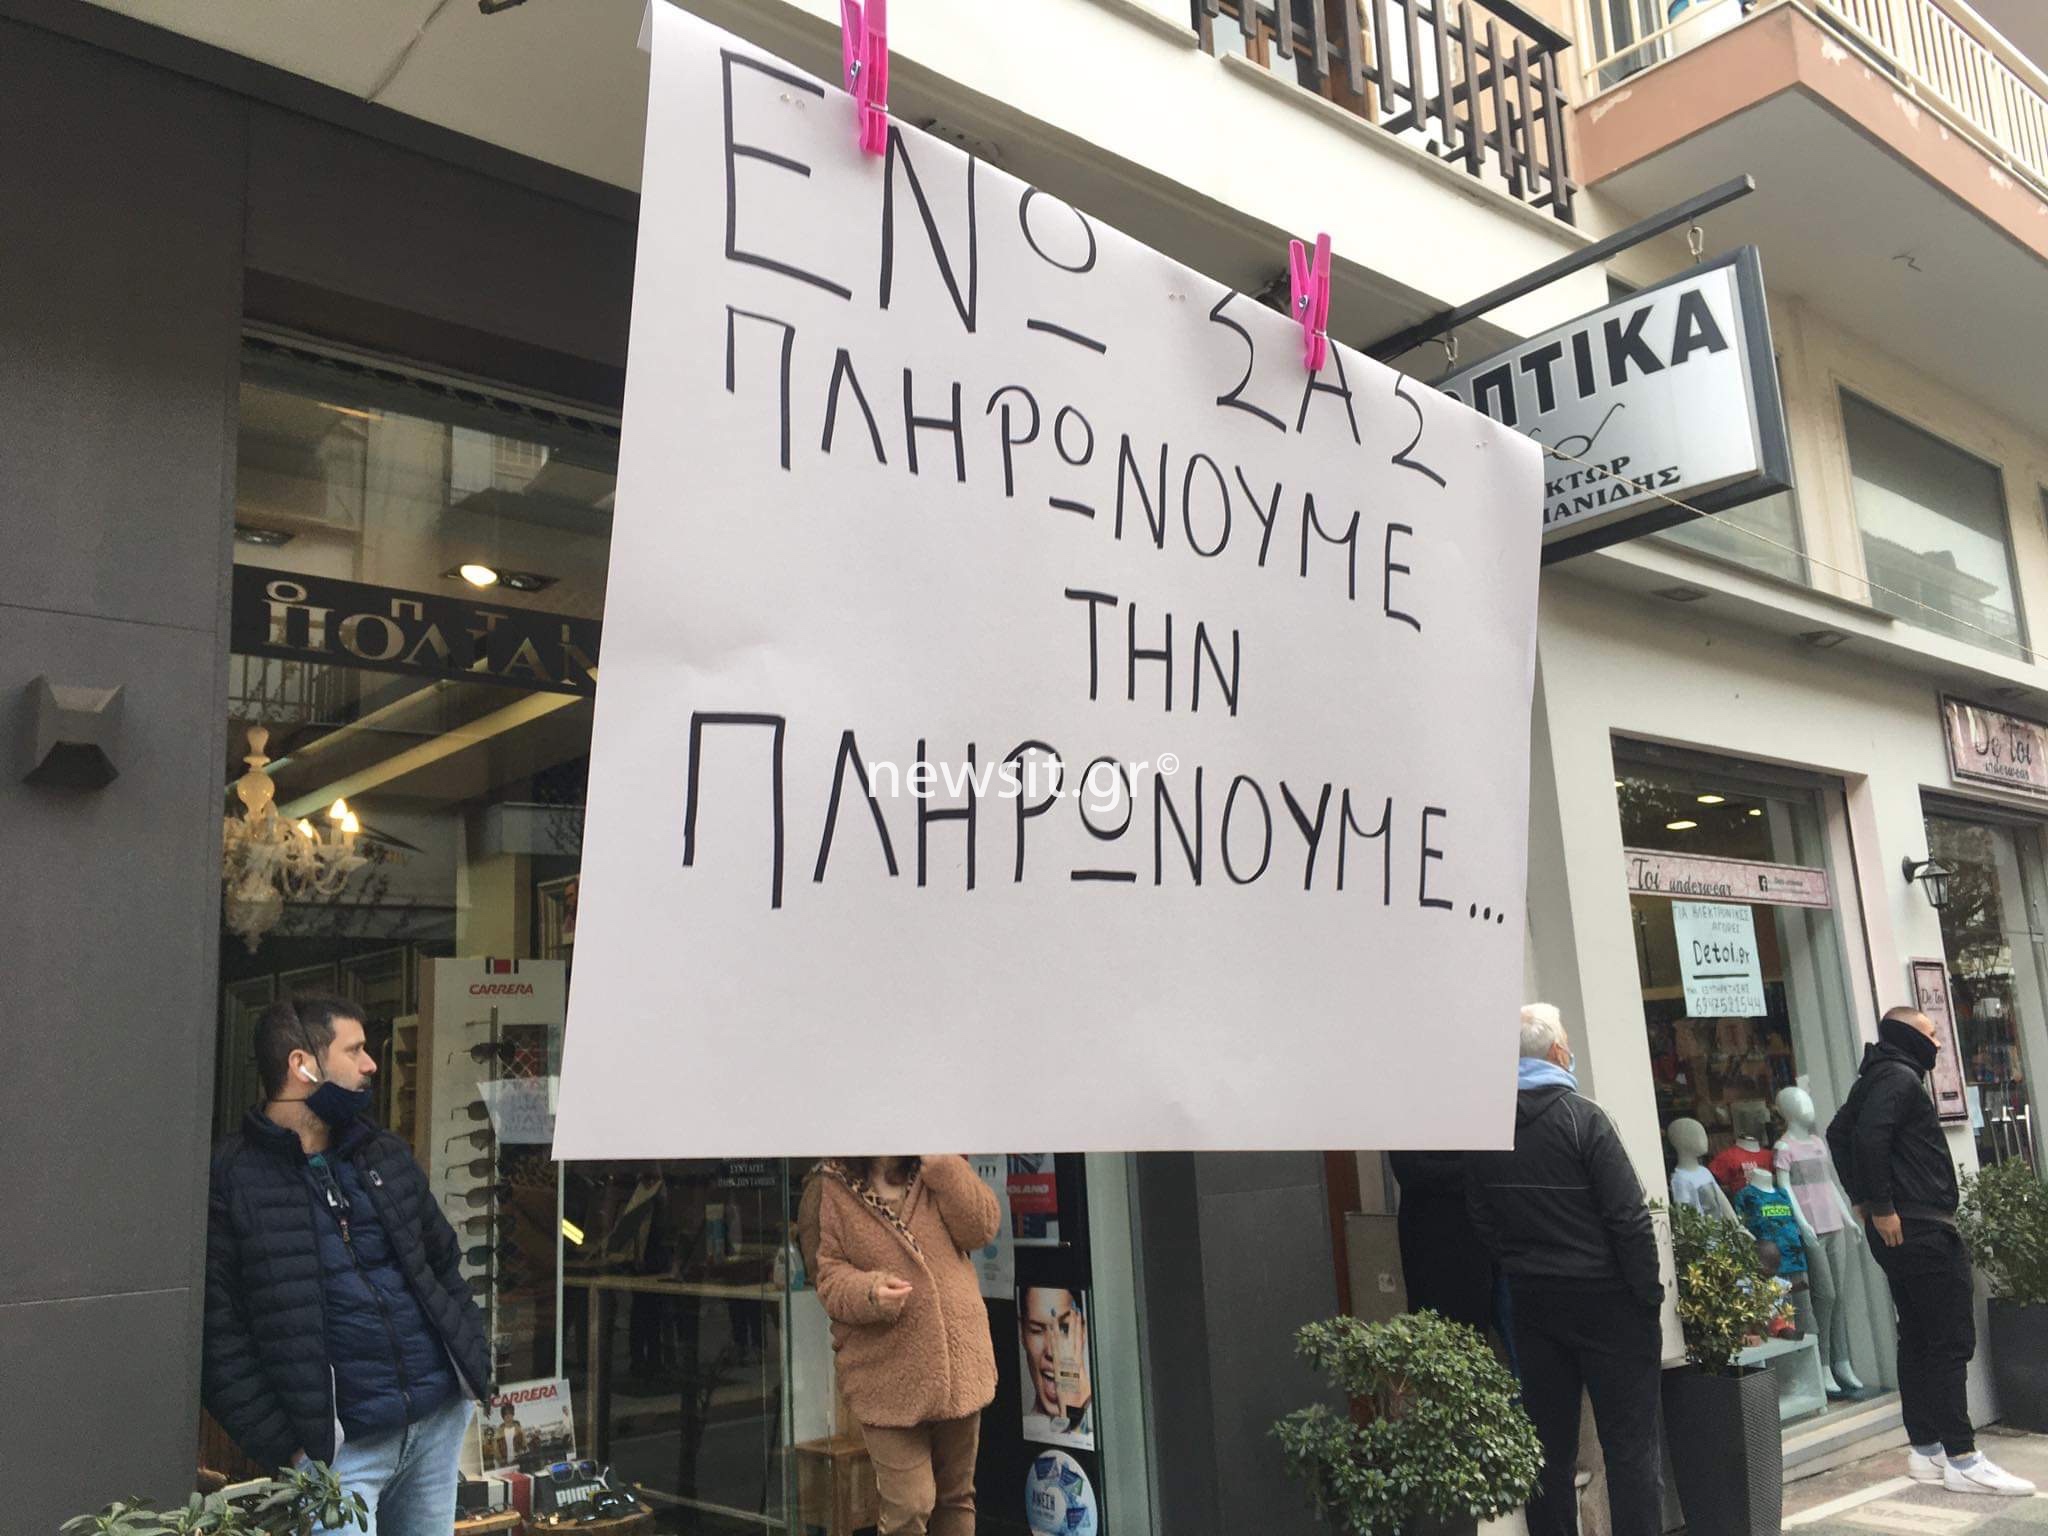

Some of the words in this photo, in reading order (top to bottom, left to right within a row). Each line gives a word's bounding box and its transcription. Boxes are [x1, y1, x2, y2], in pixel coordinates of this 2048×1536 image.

[1209, 290, 1447, 487] ΣΑΣ
[1446, 289, 1728, 427] ΠΤΙΚΑ
[725, 304, 1421, 632] ΠΛΗΡΩΝΟΥΜΕ
[1543, 466, 1681, 524] ΙΑΝΙΔΗΣ
[1545, 456, 1631, 498] ΚΤΩΡ
[260, 600, 598, 687] ΠΟΛΙΑΝ
[1065, 587, 1240, 716] ΤΗΝ
[1631, 857, 1662, 891] Toi
[1669, 874, 1733, 897] underwear
[469, 983, 534, 995] CARRERA
[491, 1385, 558, 1408] CARRERA
